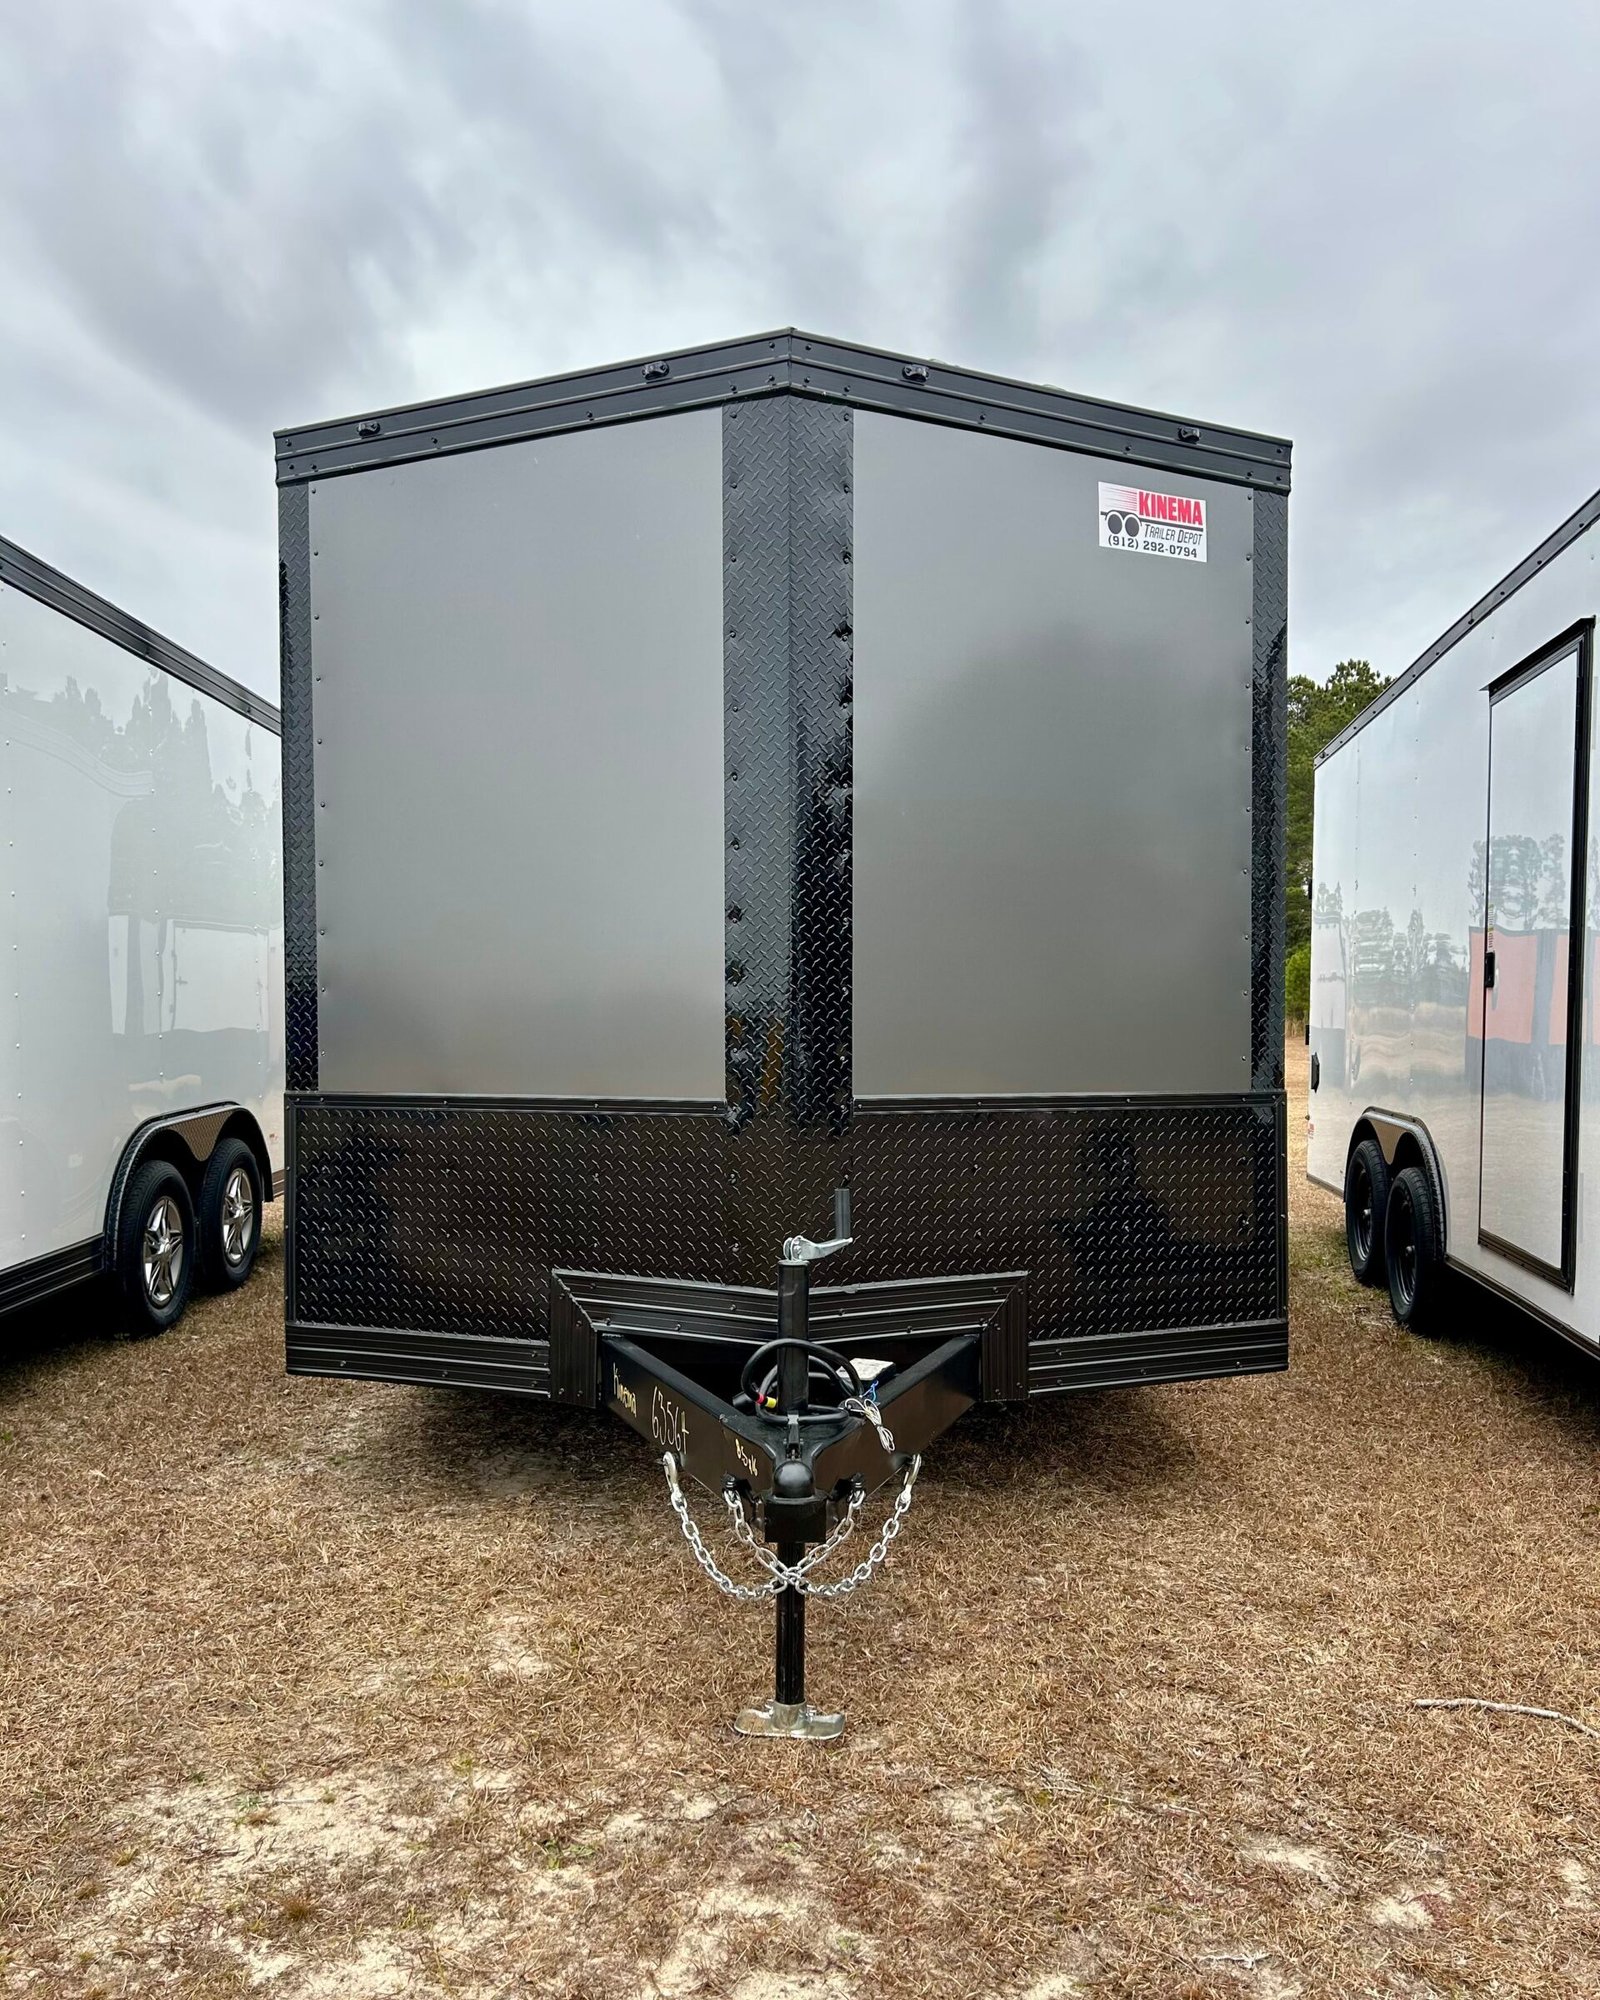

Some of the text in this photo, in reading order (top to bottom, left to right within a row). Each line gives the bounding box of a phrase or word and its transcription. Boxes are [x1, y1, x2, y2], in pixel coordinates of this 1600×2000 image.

[1139, 491, 1203, 526] KINEMA
[1144, 524, 1203, 545] TRAILER DEPOT
[1108, 535, 1197, 558] (912) 292-0794
